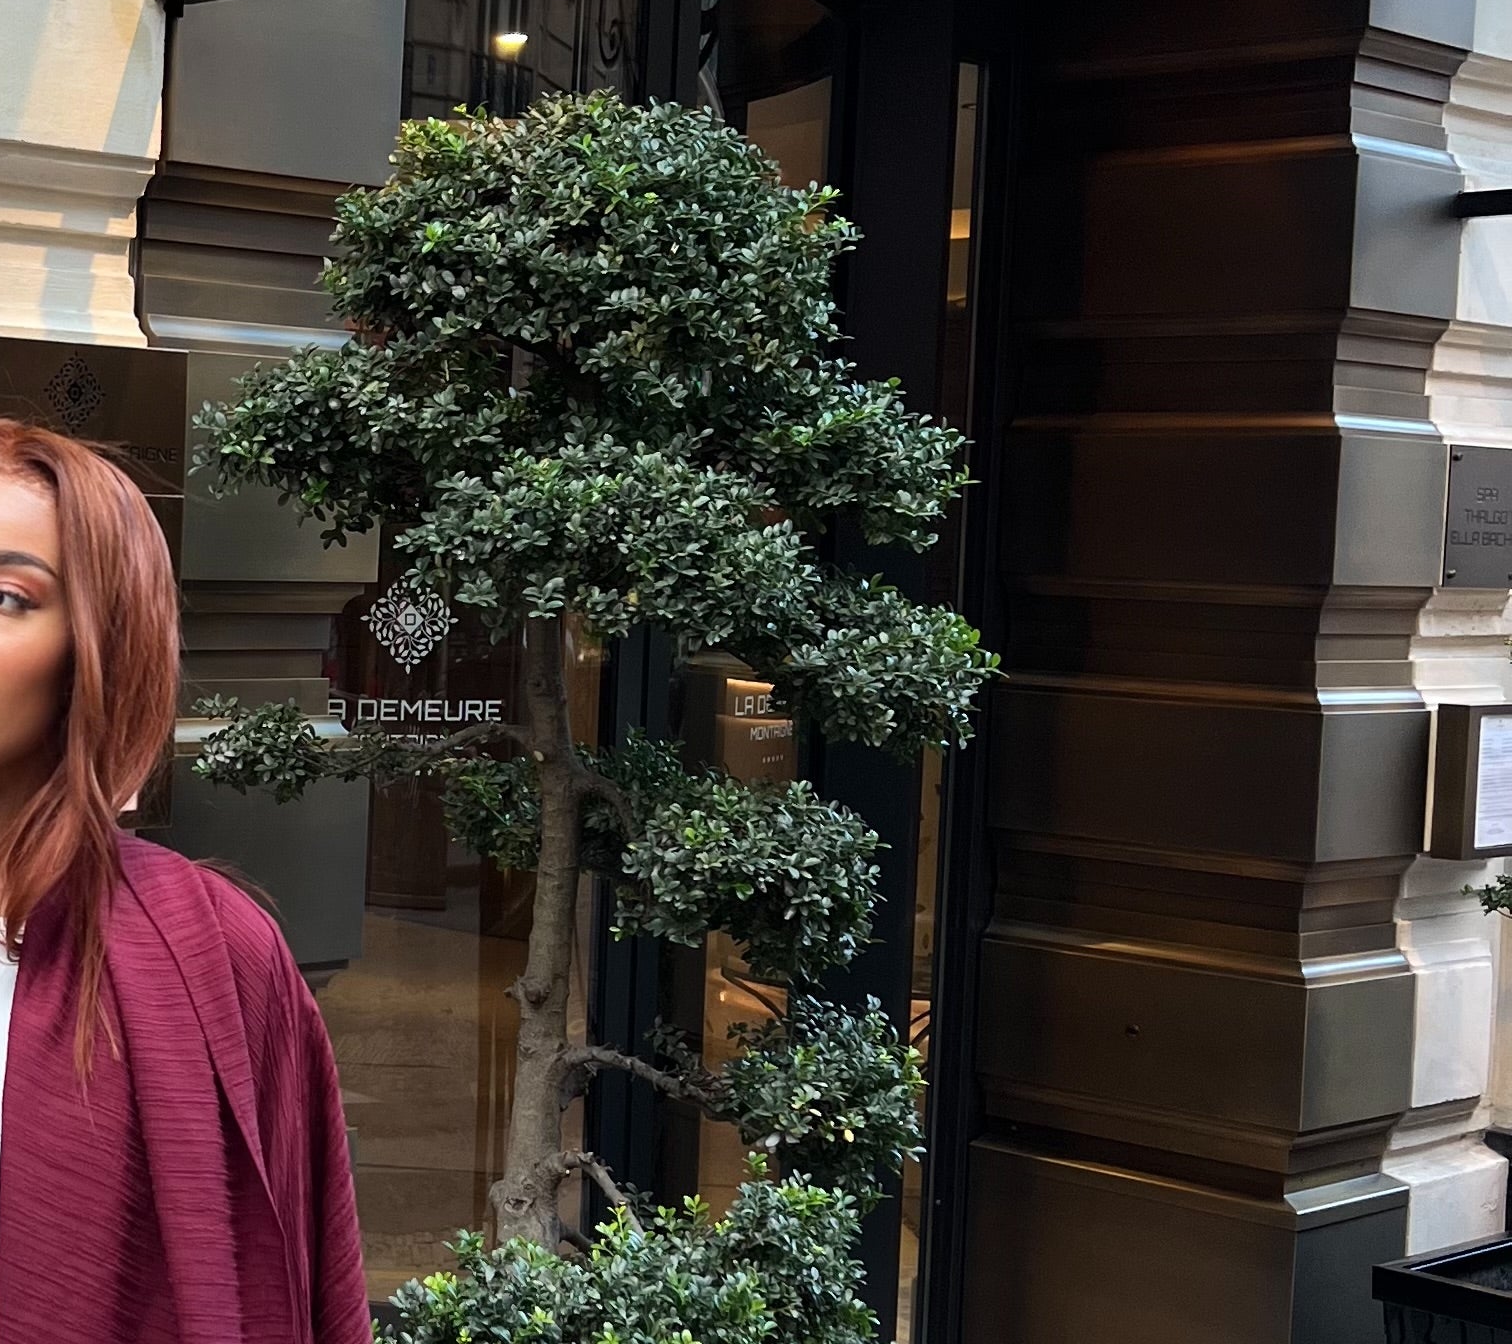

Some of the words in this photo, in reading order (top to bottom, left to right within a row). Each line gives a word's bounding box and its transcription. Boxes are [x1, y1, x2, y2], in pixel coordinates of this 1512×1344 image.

[1477, 487, 1499, 503] SPA
[1450, 530, 1480, 546] ELLA
[357, 698, 502, 722] DEMEURE
[735, 695, 754, 716] LA
